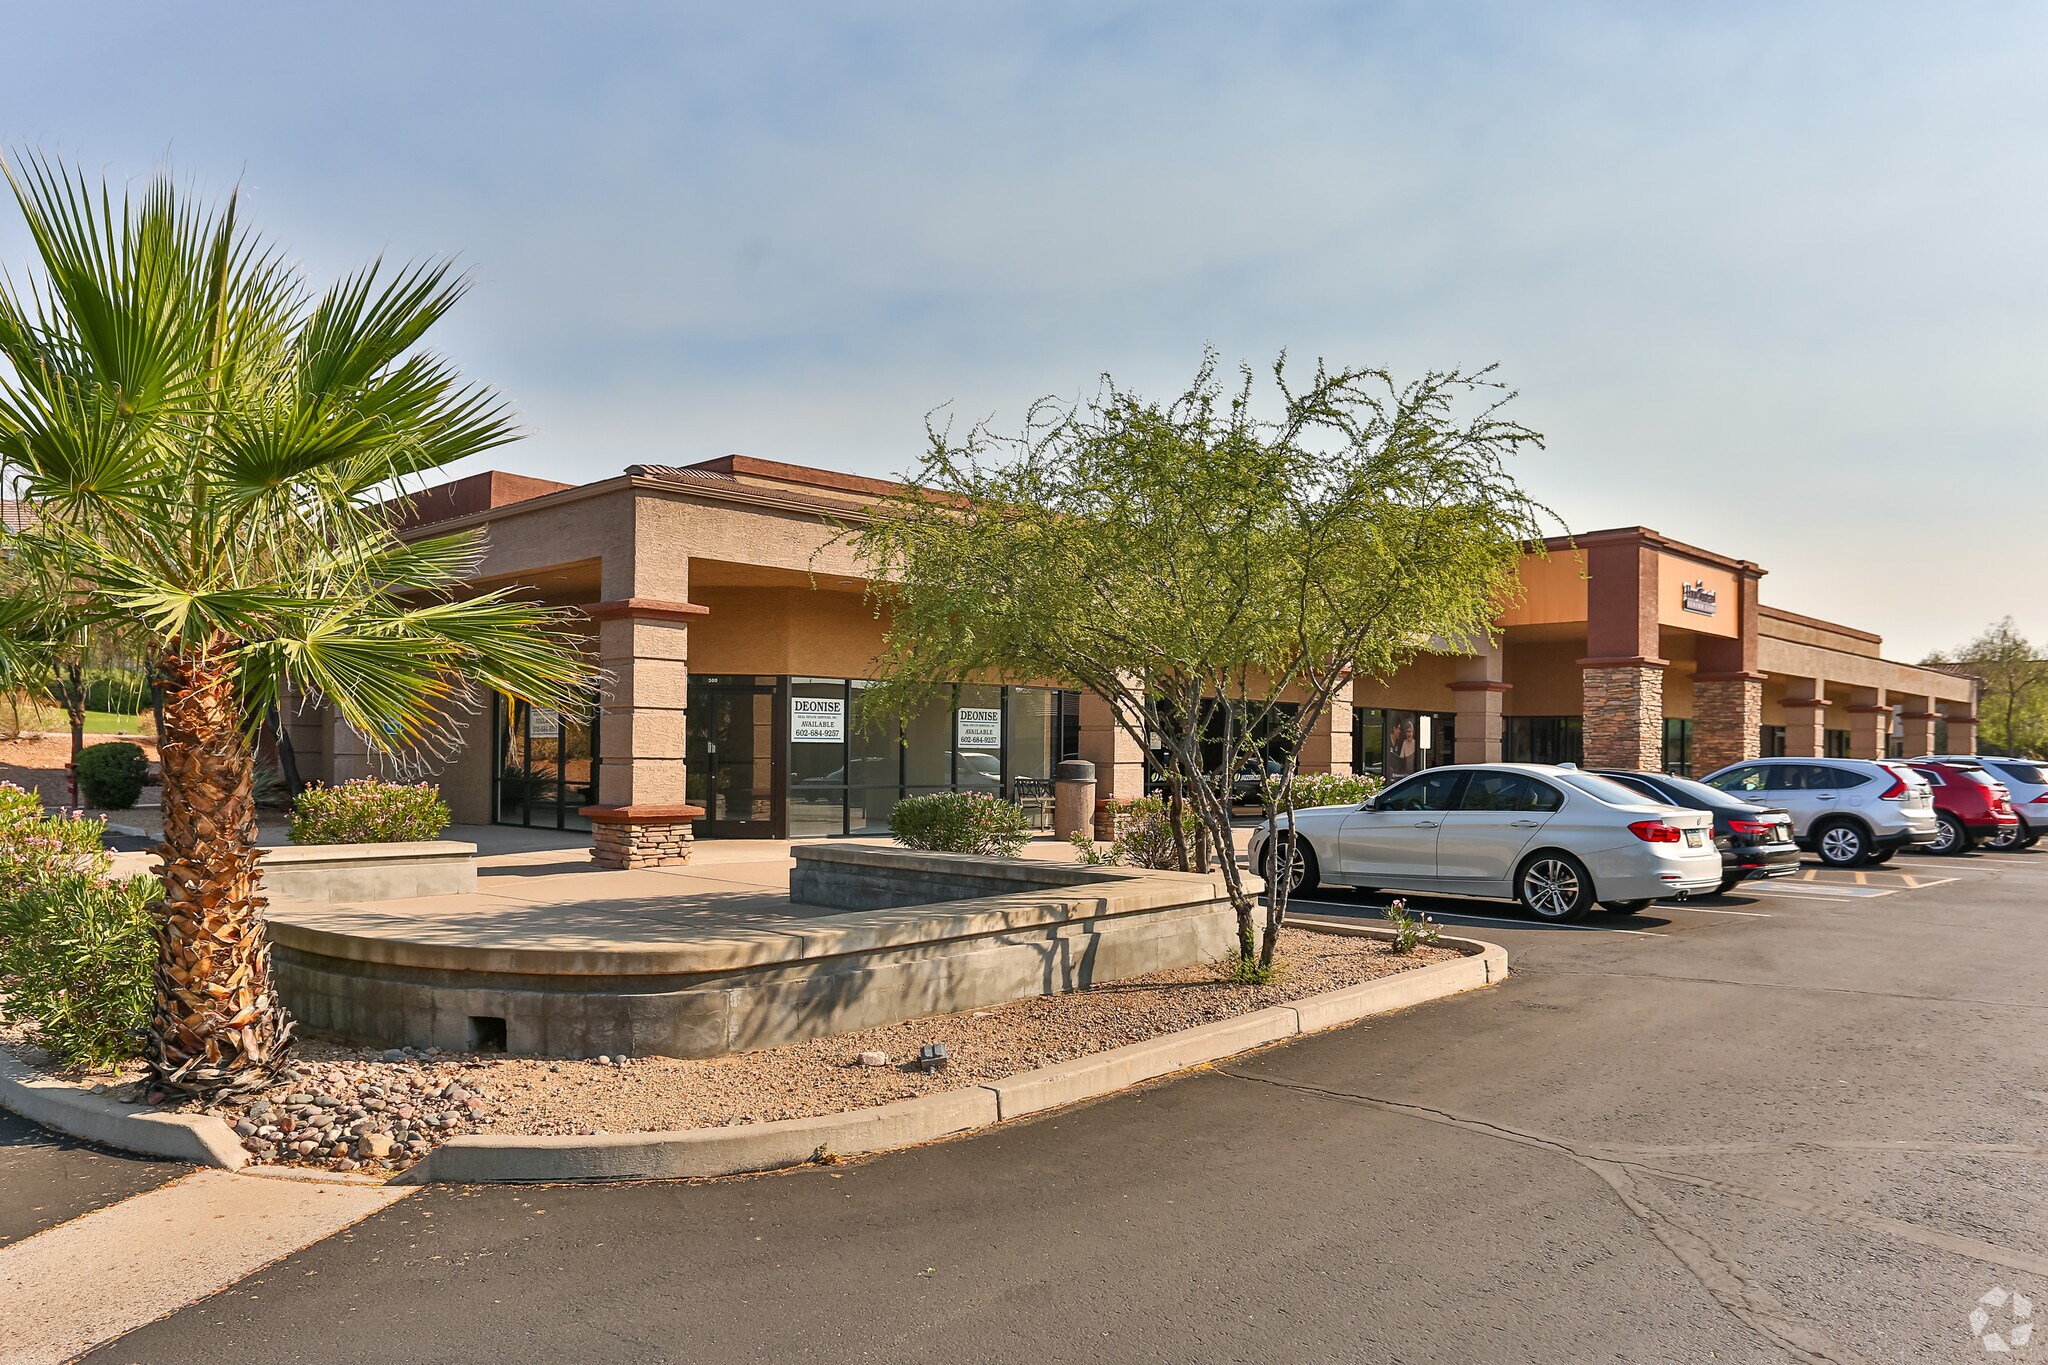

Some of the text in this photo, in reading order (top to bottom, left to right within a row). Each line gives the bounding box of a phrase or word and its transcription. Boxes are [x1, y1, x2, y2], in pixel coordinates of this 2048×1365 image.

[795, 701, 841, 712] DEONISE
[960, 711, 998, 721] DEONISE
[795, 729, 839, 737] 602-684-9257
